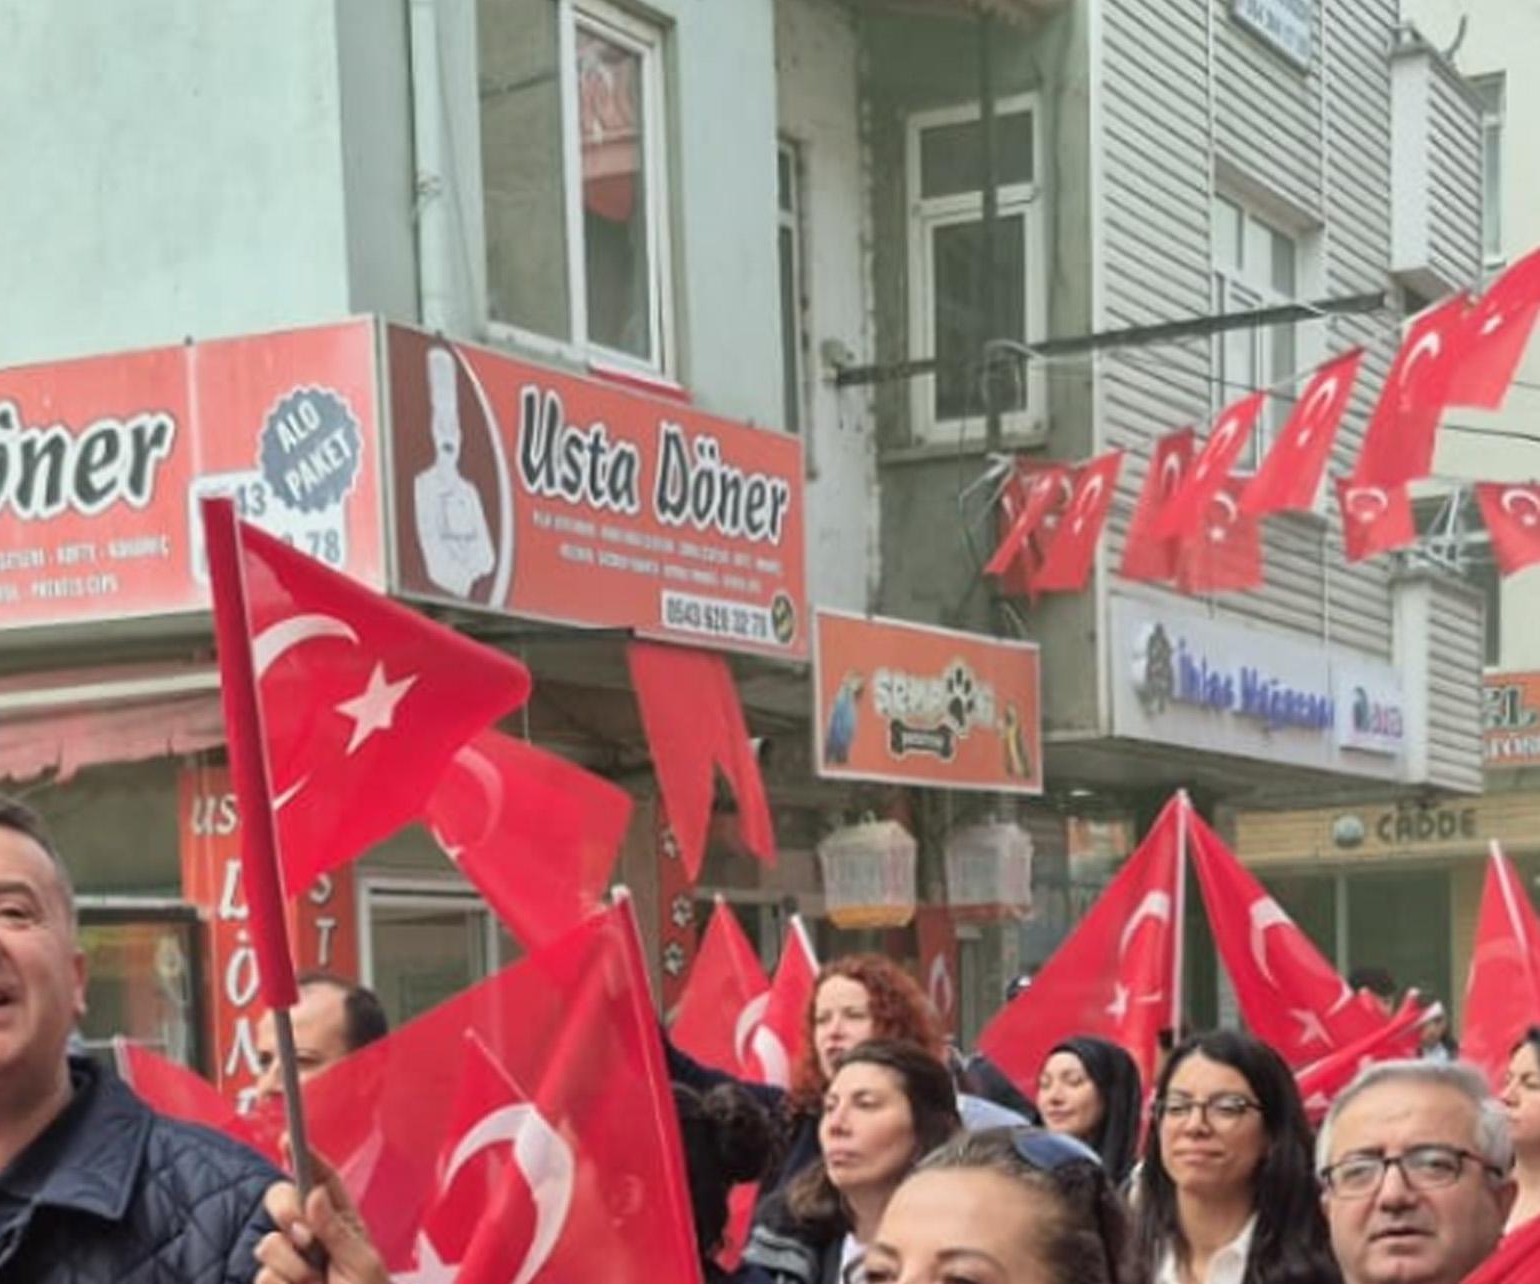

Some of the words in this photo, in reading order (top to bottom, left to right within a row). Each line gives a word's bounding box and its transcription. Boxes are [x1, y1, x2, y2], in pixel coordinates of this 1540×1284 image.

[276, 400, 321, 454] ALO
[285, 427, 352, 501] PAKET
[521, 391, 636, 507] Usta
[658, 427, 787, 538] Döner
[1377, 808, 1477, 843] CADDE
